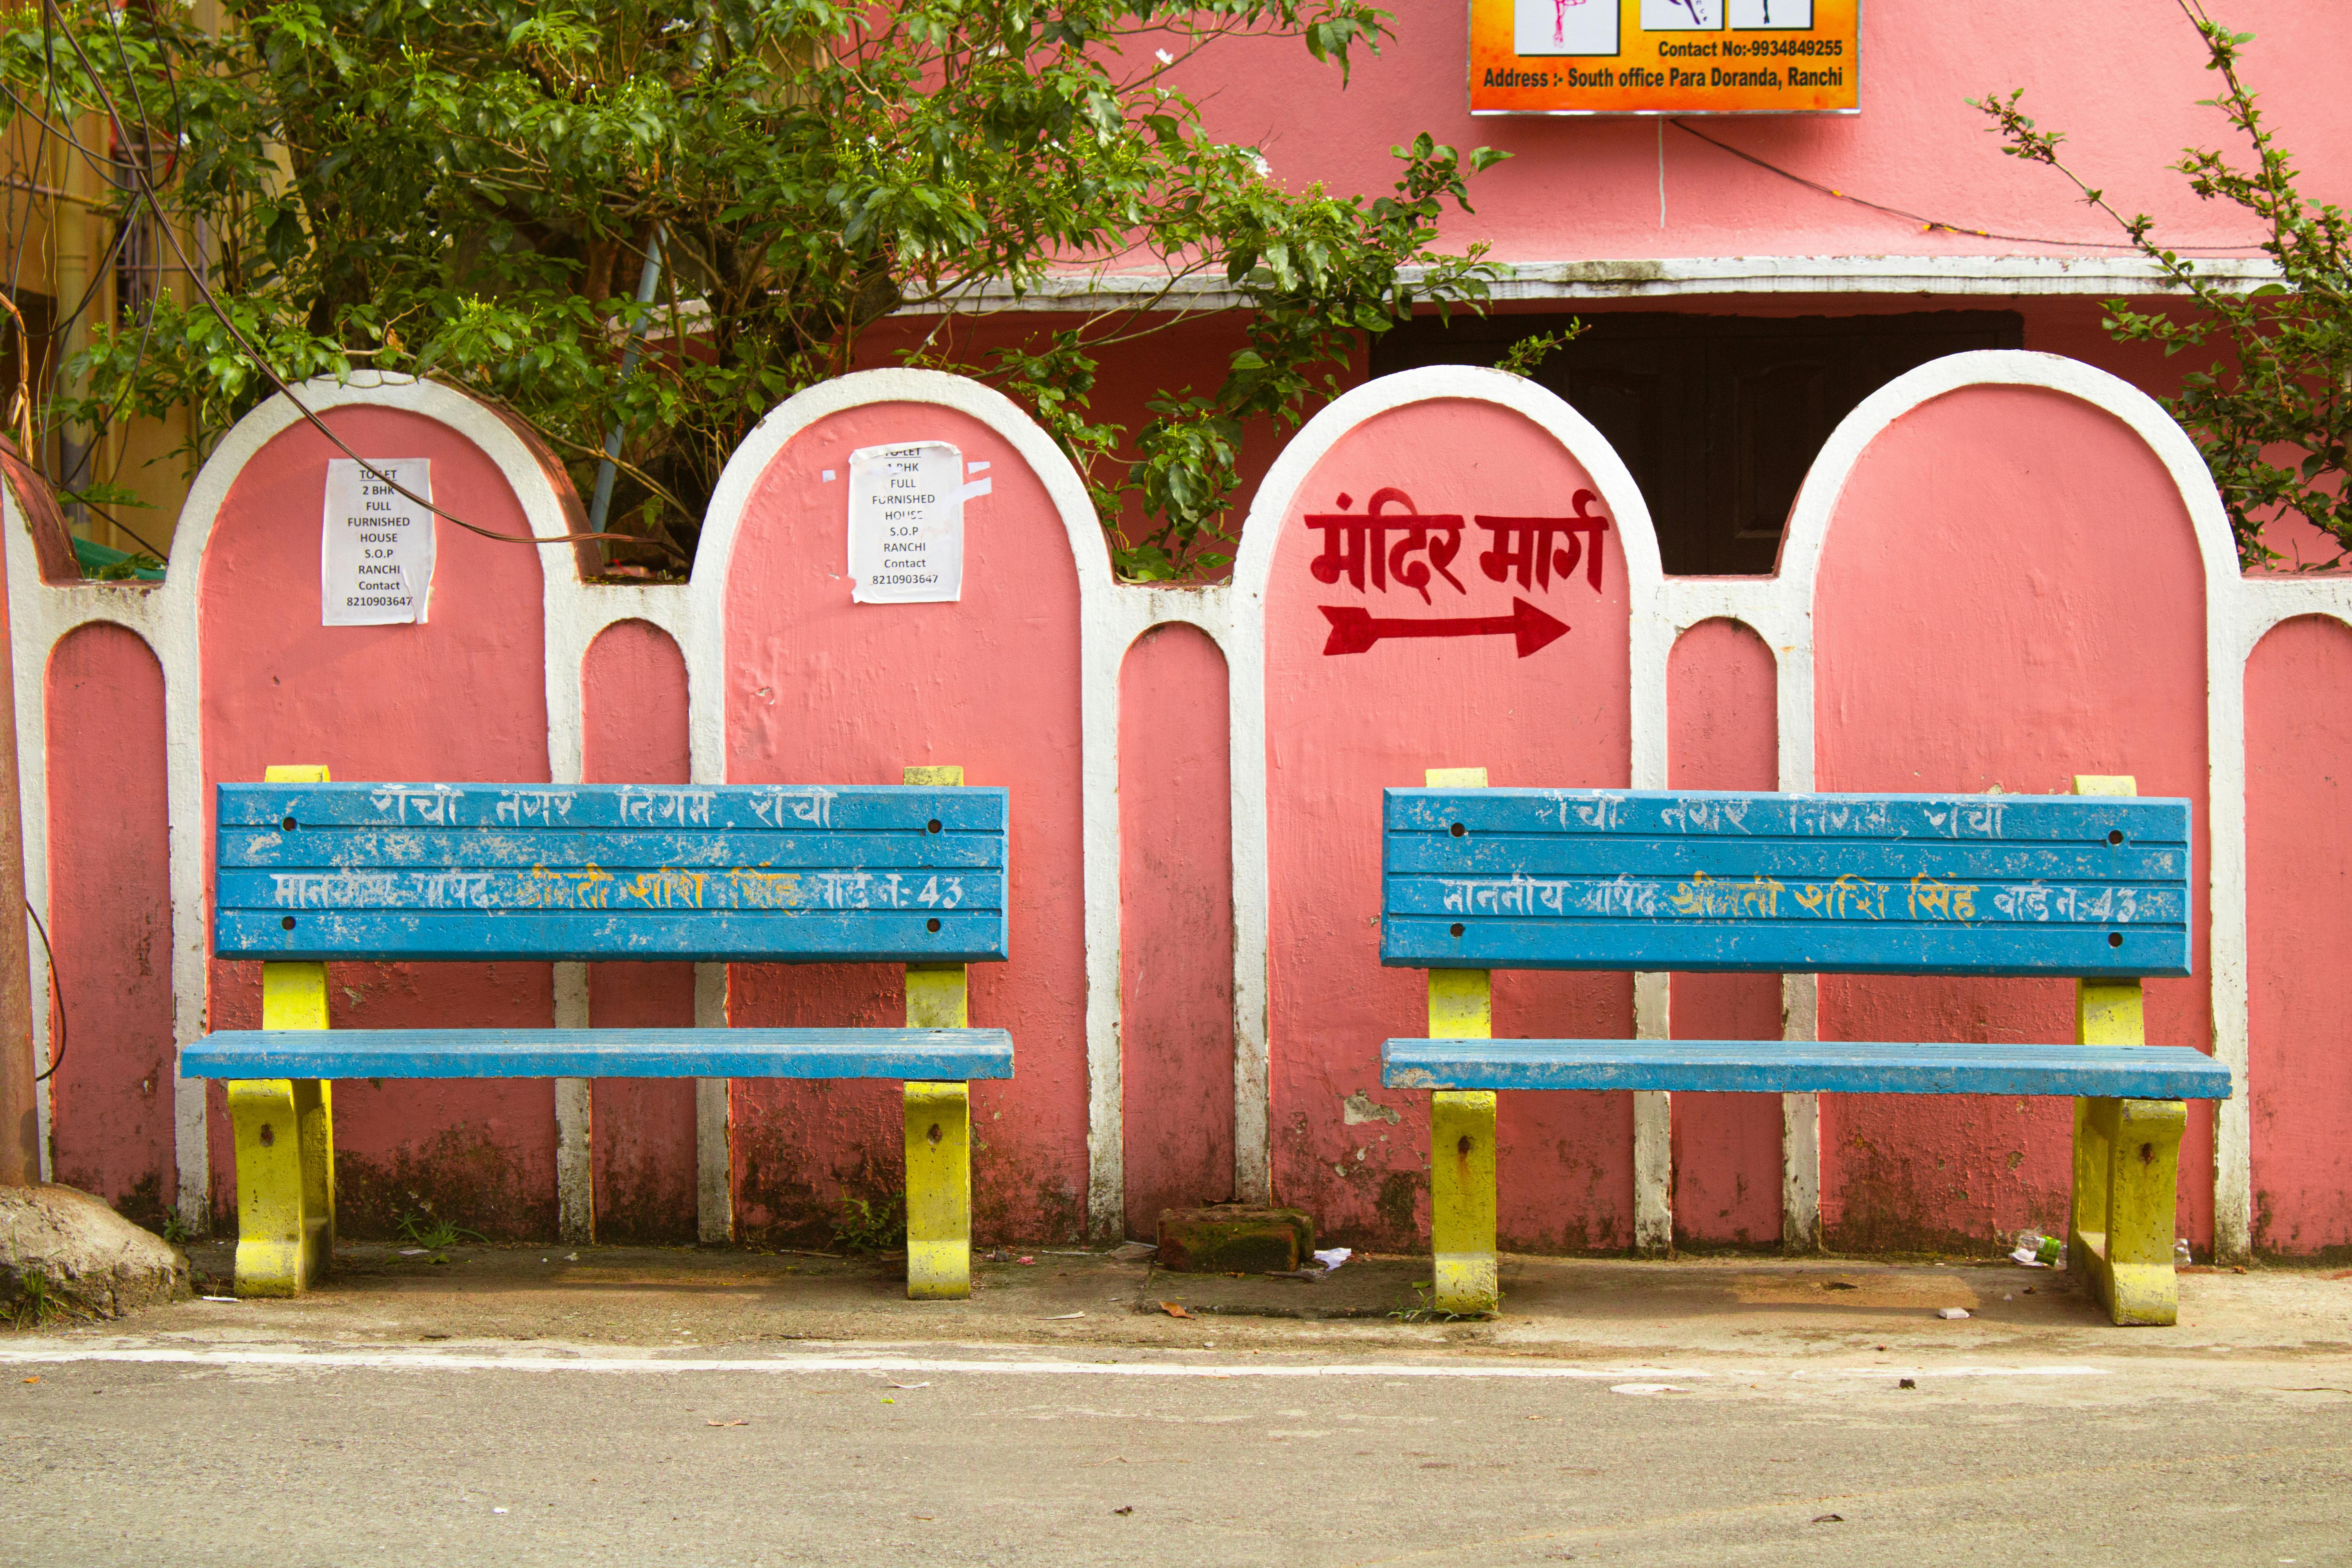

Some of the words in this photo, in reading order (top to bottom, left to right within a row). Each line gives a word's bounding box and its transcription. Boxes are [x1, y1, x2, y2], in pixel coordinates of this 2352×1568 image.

[1659, 41, 1717, 57] Contact
[1722, 40, 1843, 56] No:-9934849255
[1483, 68, 1549, 87] Address
[1568, 67, 1614, 87] South
[1619, 67, 1665, 87] office
[1670, 67, 1706, 87] Para
[1711, 67, 1782, 91] Doranda,
[1788, 67, 1843, 86] Ranchi
[359, 470, 397, 479] TOET
[890, 479, 916, 488] FULL
[363, 486, 368, 495] 2
[372, 486, 394, 495] BHK
[872, 494, 935, 505] FURNISHED
[366, 502, 392, 511] FULL
[348, 517, 410, 527] FURNISHED
[890, 527, 918, 536] S.O.P
[360, 533, 398, 543] HOUSE
[884, 543, 926, 552] RANCHI
[1303, 487, 1466, 606] मंदिर
[1474, 488, 1610, 594] मार्ग
[365, 549, 393, 558] S.O.P
[884, 559, 926, 568] Contact
[358, 565, 400, 574] RANCHI
[872, 575, 938, 584] 8210903647
[359, 581, 400, 590] Contact
[347, 597, 413, 606] 8210903647
[495, 789, 578, 827] नगर
